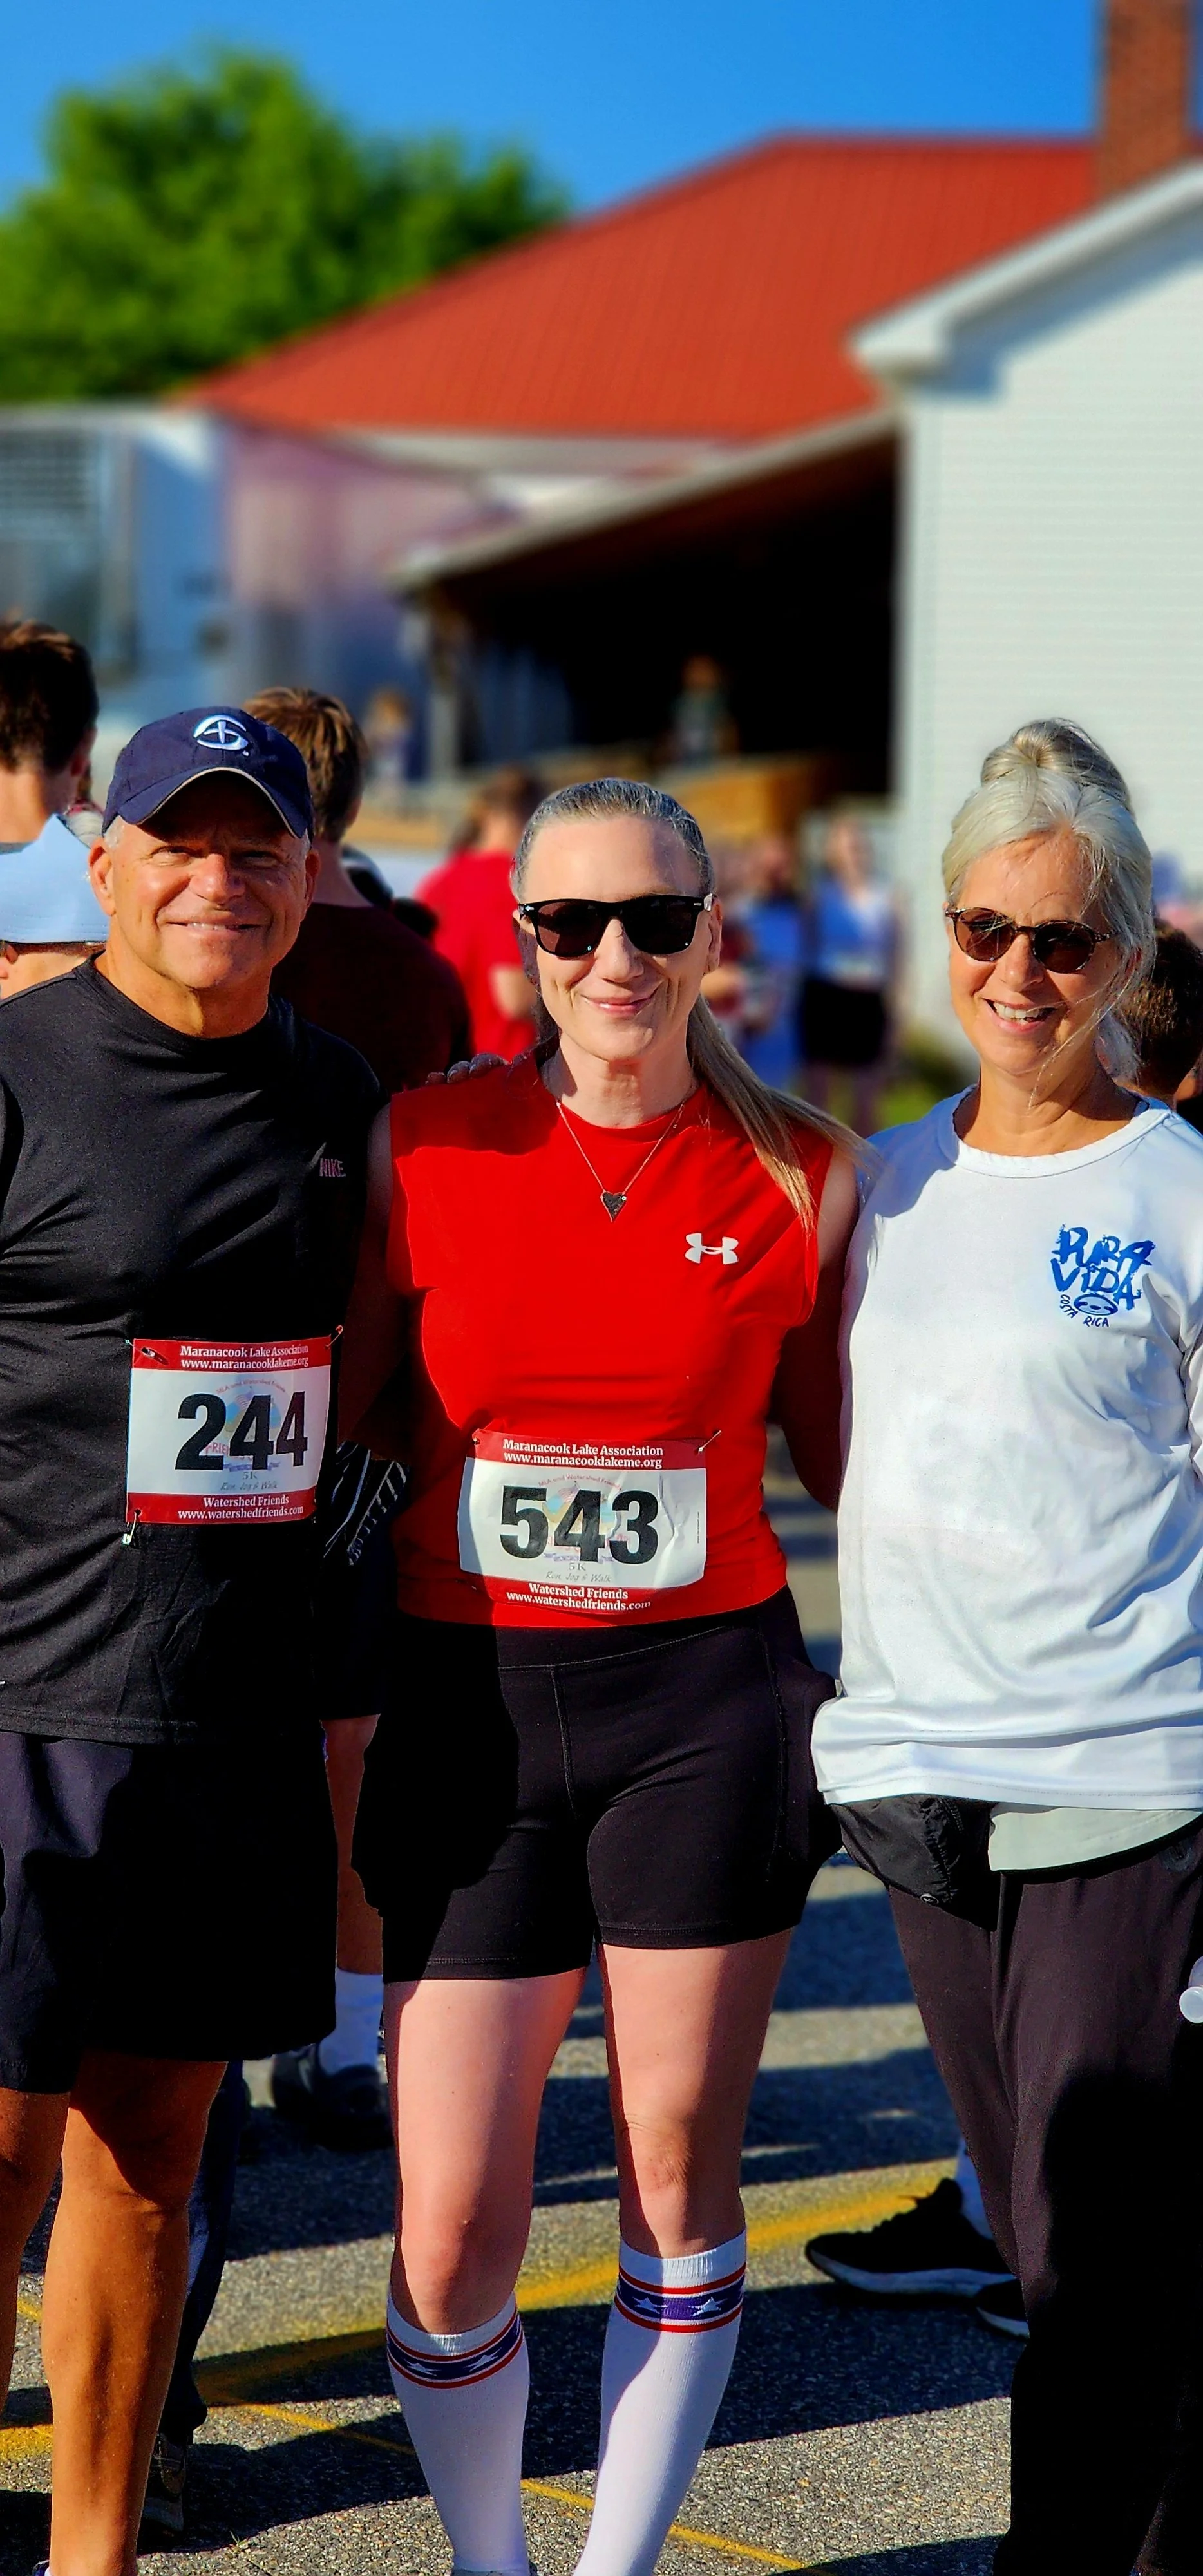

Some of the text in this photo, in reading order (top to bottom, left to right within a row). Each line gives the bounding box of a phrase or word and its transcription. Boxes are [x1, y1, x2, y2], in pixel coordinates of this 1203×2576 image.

[319, 1158, 346, 1178] NIKE
[1059, 1294, 1110, 1327] COSTA RICA
[180, 1343, 309, 1358] Maranacook Lake Association
[181, 1356, 309, 1370] www.maranacooklakeme.org
[175, 1390, 308, 1470] 244
[502, 1439, 663, 1456] Maranacook Lake Association
[504, 1452, 663, 1469] www.maranacooklakeme.org
[242, 1471, 258, 1480] 5K
[203, 1494, 290, 1508] Watershed Friends
[178, 1506, 303, 1519] www.watershedfriends.com
[500, 1484, 659, 1565] 543
[569, 1562, 586, 1571] 5K
[565, 1572, 580, 1581] Jog
[590, 1573, 611, 1583] Walk
[529, 1582, 629, 1600] Watershed Friends
[506, 1592, 650, 1611] www.watershedfriends.com
